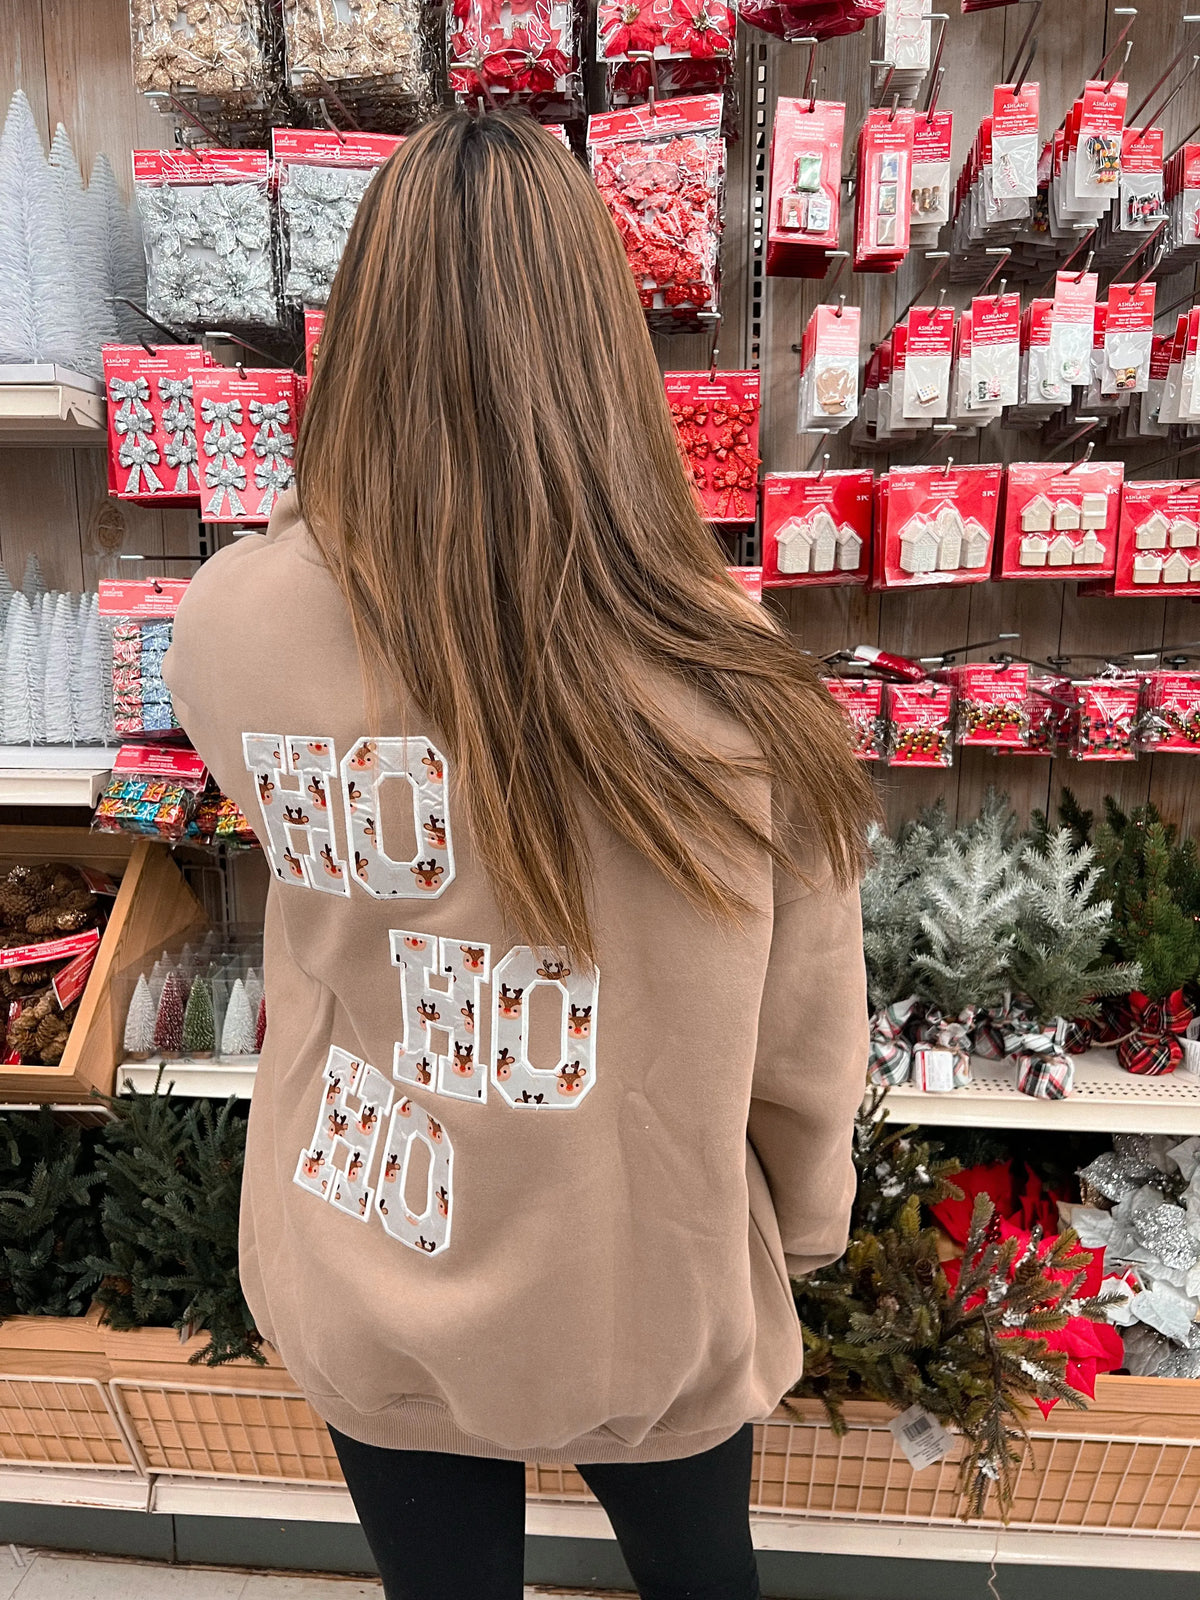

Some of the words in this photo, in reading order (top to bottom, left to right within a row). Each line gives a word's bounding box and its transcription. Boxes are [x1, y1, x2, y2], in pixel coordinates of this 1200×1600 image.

[981, 312, 1009, 320] ASHLAND
[241, 732, 456, 899] HO
[388, 929, 600, 1110] HO
[292, 1045, 454, 1257] HO
